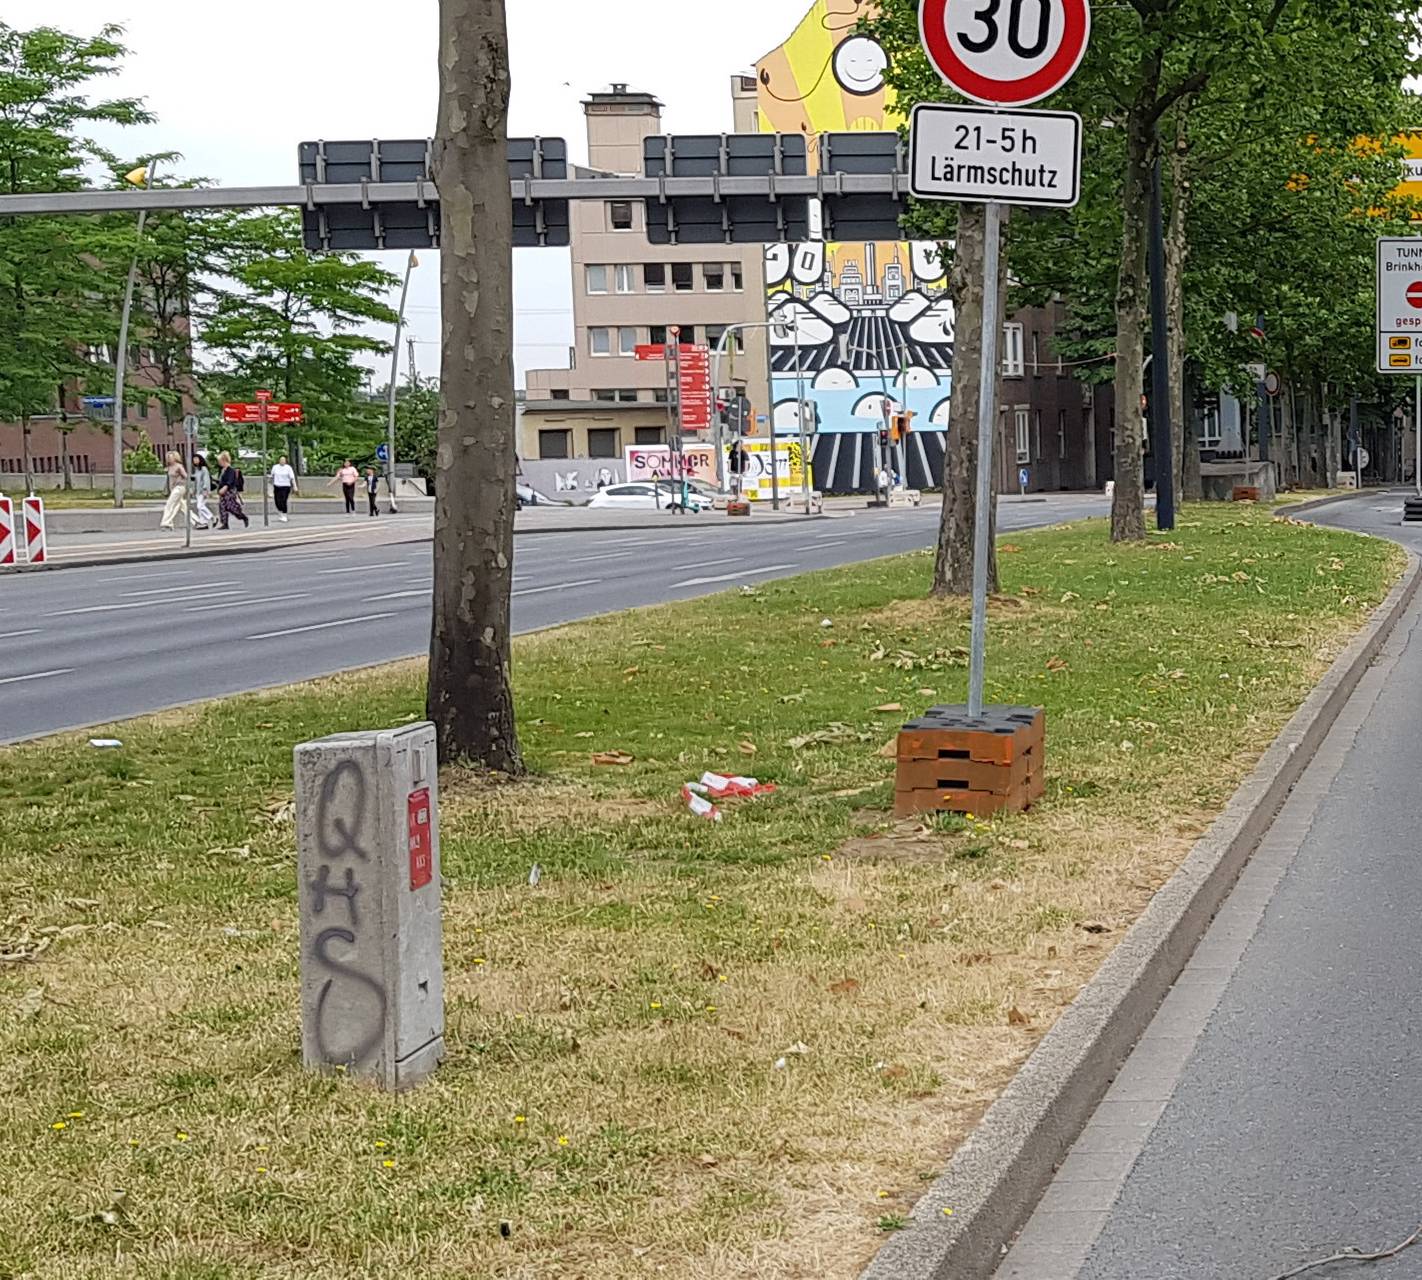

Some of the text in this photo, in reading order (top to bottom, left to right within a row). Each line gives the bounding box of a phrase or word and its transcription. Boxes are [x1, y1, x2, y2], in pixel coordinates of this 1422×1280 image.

[957, 0, 1051, 59] 30
[954, 125, 1037, 154] 21-5 h
[931, 156, 1058, 188] Lärmschutz
